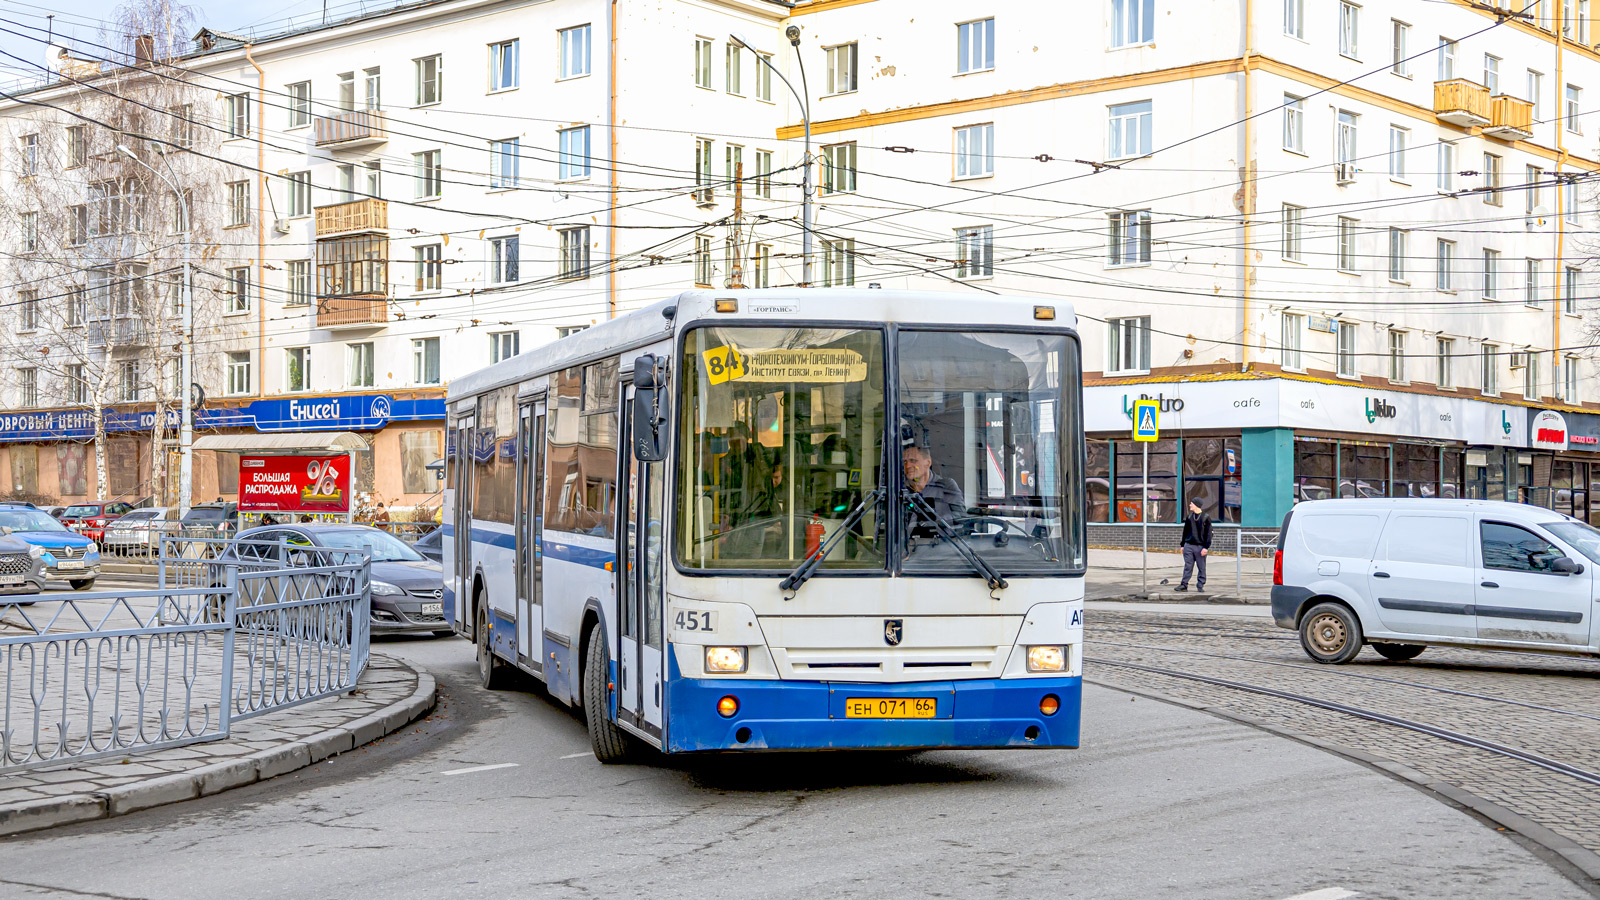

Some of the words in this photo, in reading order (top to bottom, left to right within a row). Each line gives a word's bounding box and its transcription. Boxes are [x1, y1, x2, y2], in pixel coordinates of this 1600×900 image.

[709, 352, 739, 376] 84
[1233, 398, 1261, 408] cafe
[1300, 400, 1315, 409] cafe
[289, 399, 340, 420] Енисей
[1439, 413, 1452, 422] cafe
[253, 472, 290, 482] БОЛЬШАЯ
[245, 484, 298, 495] РАСПРОДАЖА
[423, 604, 443, 612] Р156
[675, 610, 714, 631] 451
[854, 703, 872, 715] ЕН
[879, 700, 906, 715] 071
[915, 699, 930, 711] 66
